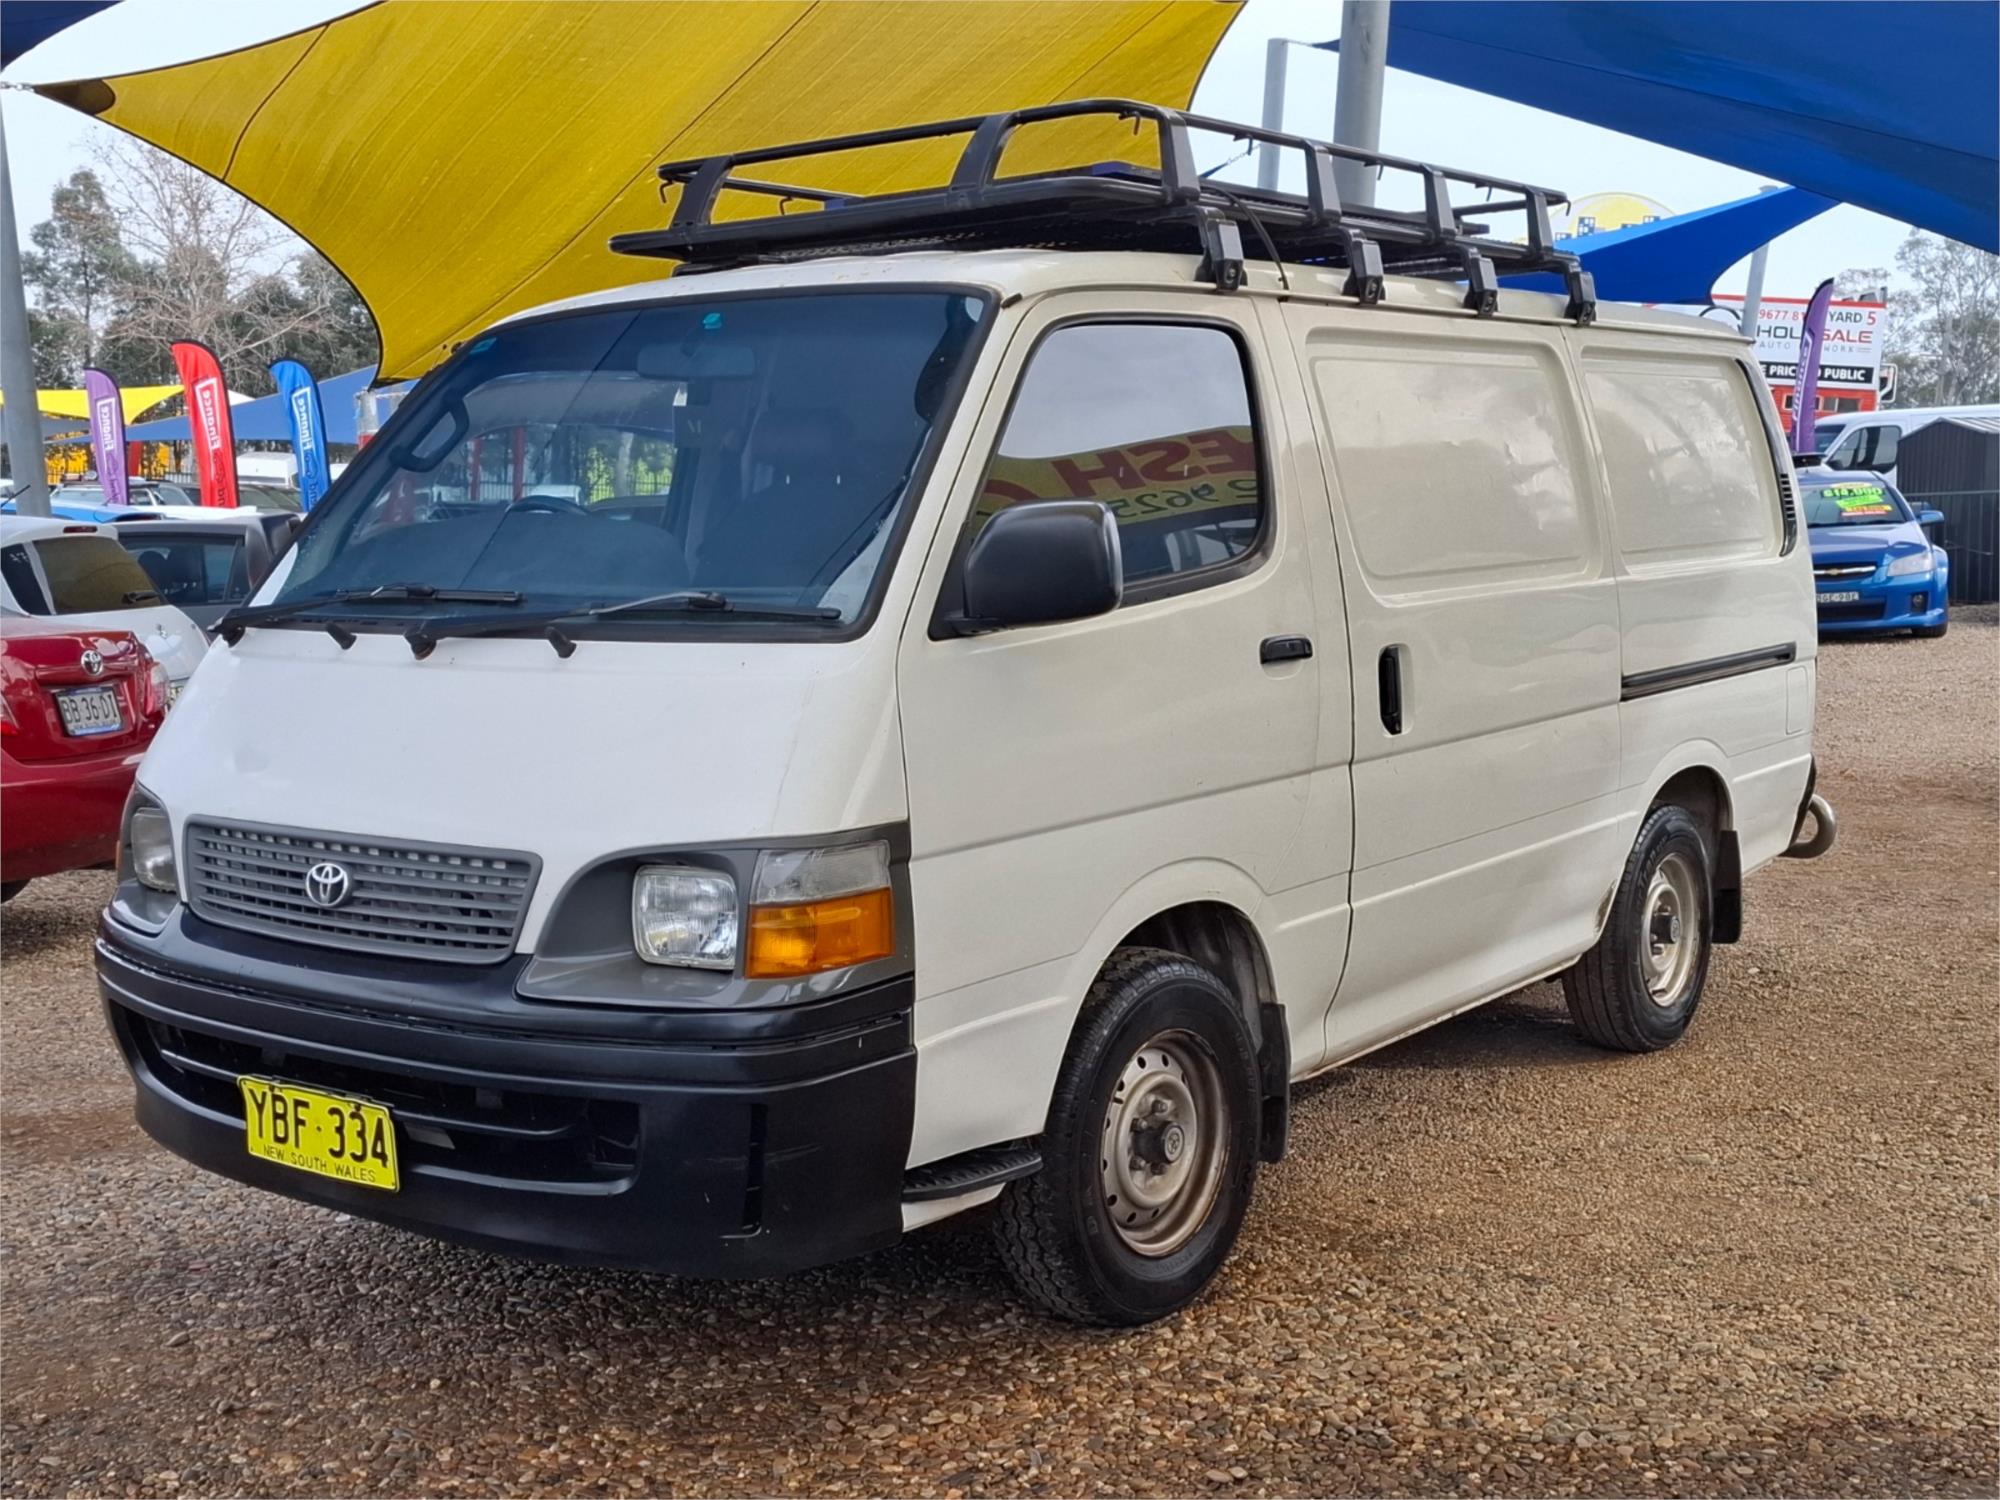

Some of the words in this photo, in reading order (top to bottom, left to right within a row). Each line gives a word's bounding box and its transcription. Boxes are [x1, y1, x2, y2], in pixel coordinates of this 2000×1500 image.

[1759, 309, 1788, 320] 9677
[1829, 311, 1863, 324] YARD
[1867, 311, 1877, 326] 5
[1760, 341, 1791, 350] AUTO
[1770, 365, 1797, 378] PRIC
[1824, 368, 1866, 381] PUBLIC
[263, 1145, 285, 1161] NEW
[291, 1152, 327, 1172] SOUTH
[335, 1164, 376, 1183] WALES
